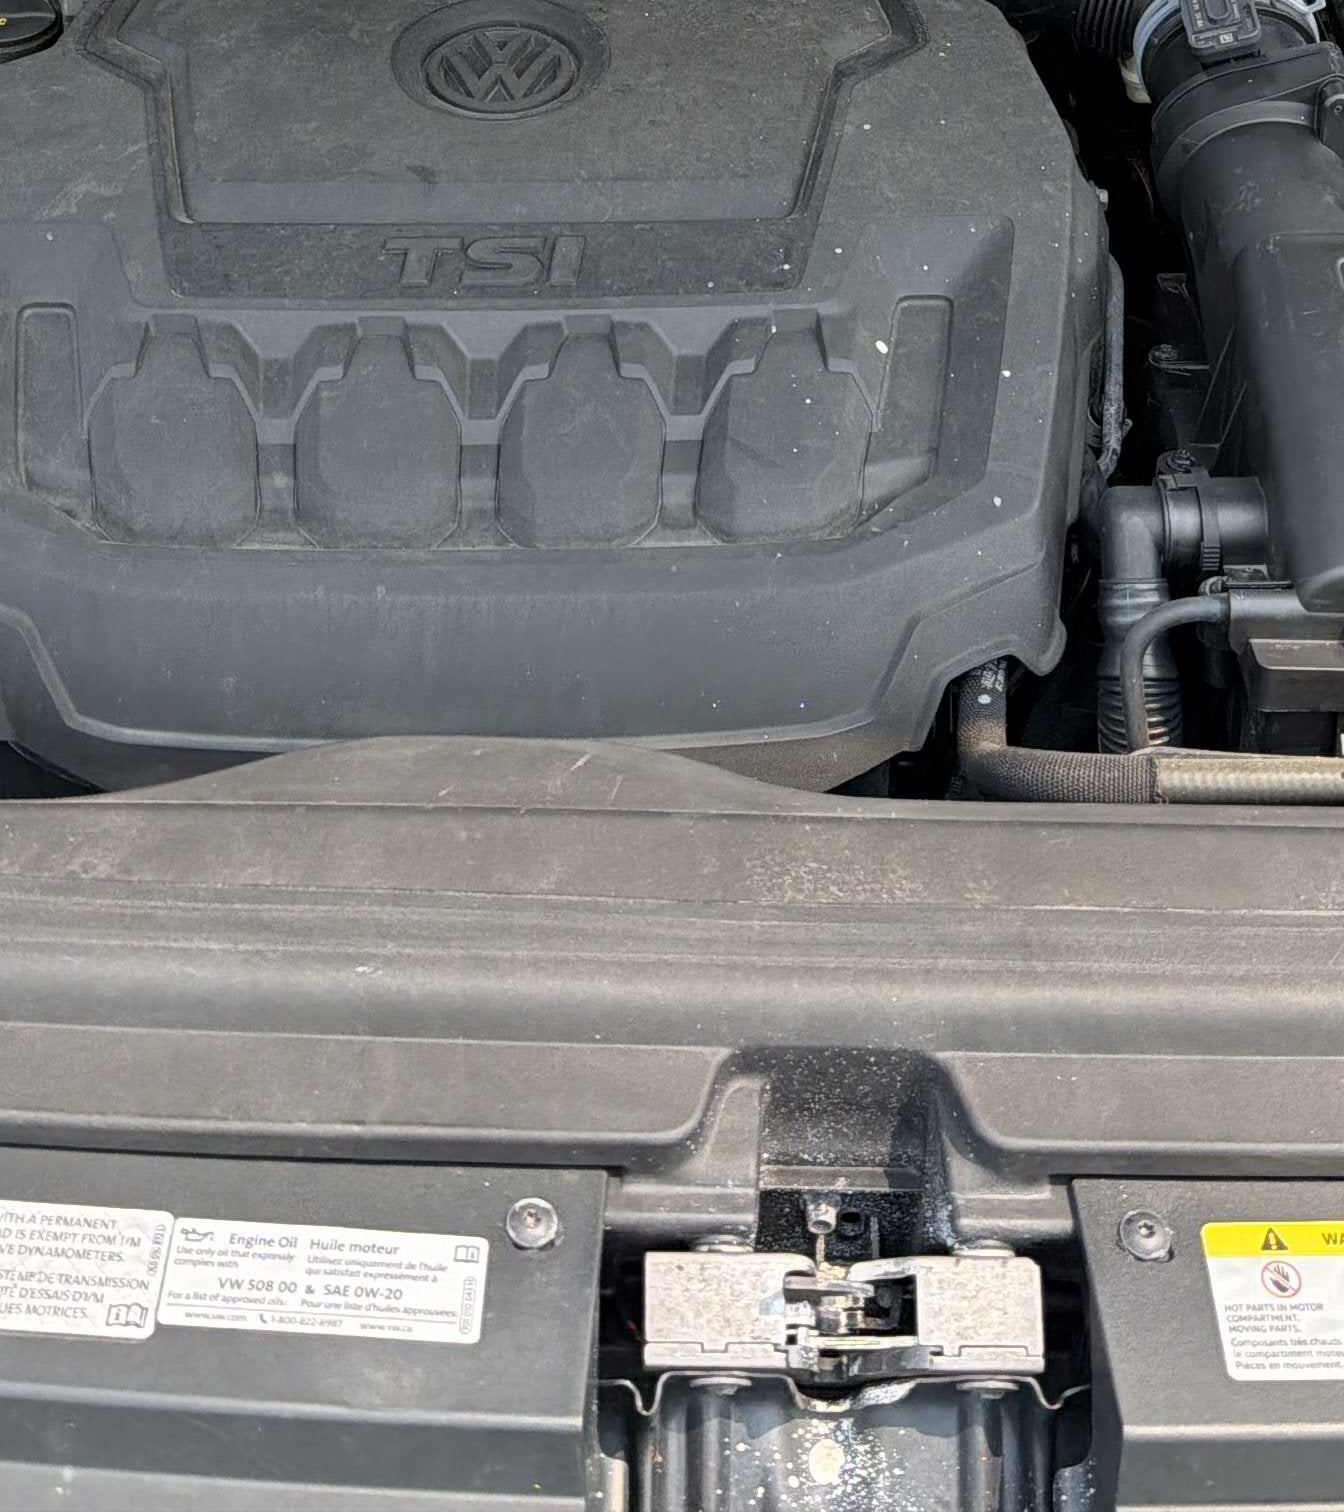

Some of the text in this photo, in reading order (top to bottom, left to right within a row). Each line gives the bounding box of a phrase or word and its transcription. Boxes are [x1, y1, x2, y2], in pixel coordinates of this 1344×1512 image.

[426, 23, 577, 116] VW
[383, 236, 586, 288] TSI
[28, 1213, 37, 1225] A
[40, 1214, 117, 1231] PERMANENT
[15, 1228, 26, 1240] IS
[28, 1228, 77, 1243] EXEMPT
[81, 1233, 117, 1246] FROM
[229, 1233, 298, 1249] Engine Oil
[17, 1244, 125, 1262] DYNAMOMETERS.
[176, 1245, 296, 1263] Use only oil that expressly
[309, 1238, 400, 1255] Huile moteur
[174, 1258, 239, 1269] complies with
[307, 1255, 343, 1266] Utilisez
[344, 1258, 403, 1270] uniquement
[405, 1260, 417, 1270] de
[37, 1271, 54, 1284] DE
[58, 1273, 150, 1290] TRANSMISSION
[323, 1268, 361, 1279] satisfait
[217, 1277, 403, 1301] VW 508 00 & SAE 0W-20
[168, 1290, 184, 1300] For
[192, 1291, 207, 1301] list
[208, 1292, 220, 1302] of
[220, 1294, 266, 1307] approved
[300, 1297, 364, 1311] Pour une liste
[25, 1304, 89, 1320] MOTRICES.
[1224, 1302, 1324, 1312] HOT PARTS IN MOTOR
[1228, 1324, 1268, 1333] MOVING
[1230, 1337, 1290, 1348] Composants
[1309, 1337, 1343, 1346] chauds
[1244, 1348, 1313, 1360] compartiment
[1268, 1362, 1281, 1370] en
